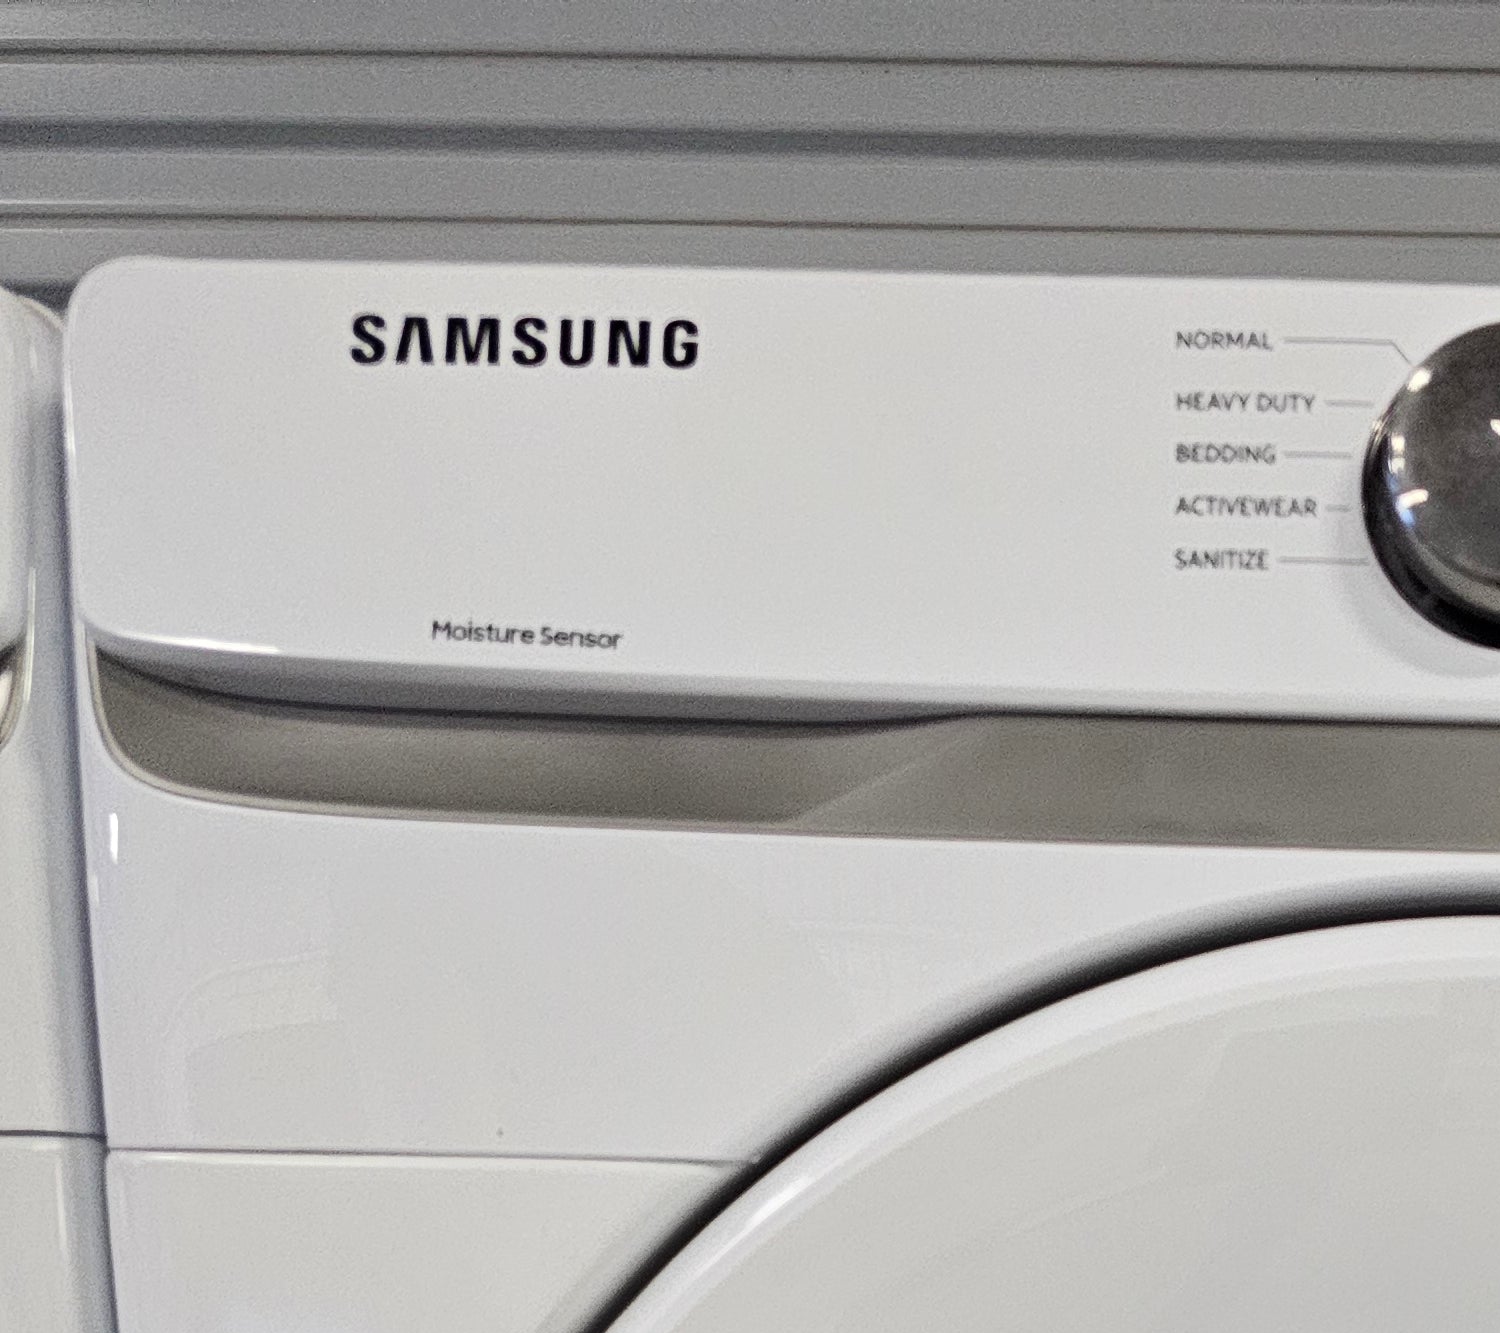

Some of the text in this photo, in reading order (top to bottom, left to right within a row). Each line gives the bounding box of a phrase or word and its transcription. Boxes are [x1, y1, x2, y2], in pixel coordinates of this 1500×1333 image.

[349, 311, 701, 370] SAMSUNG
[1174, 330, 1275, 351] NORMAL
[1174, 391, 1317, 414] HEAVY DUTY
[1174, 443, 1278, 466] BEDDING
[1173, 495, 1320, 519] ACTIVEWEAR
[1173, 548, 1271, 571] SANITIZE
[430, 617, 625, 651] Moisture Sensor
